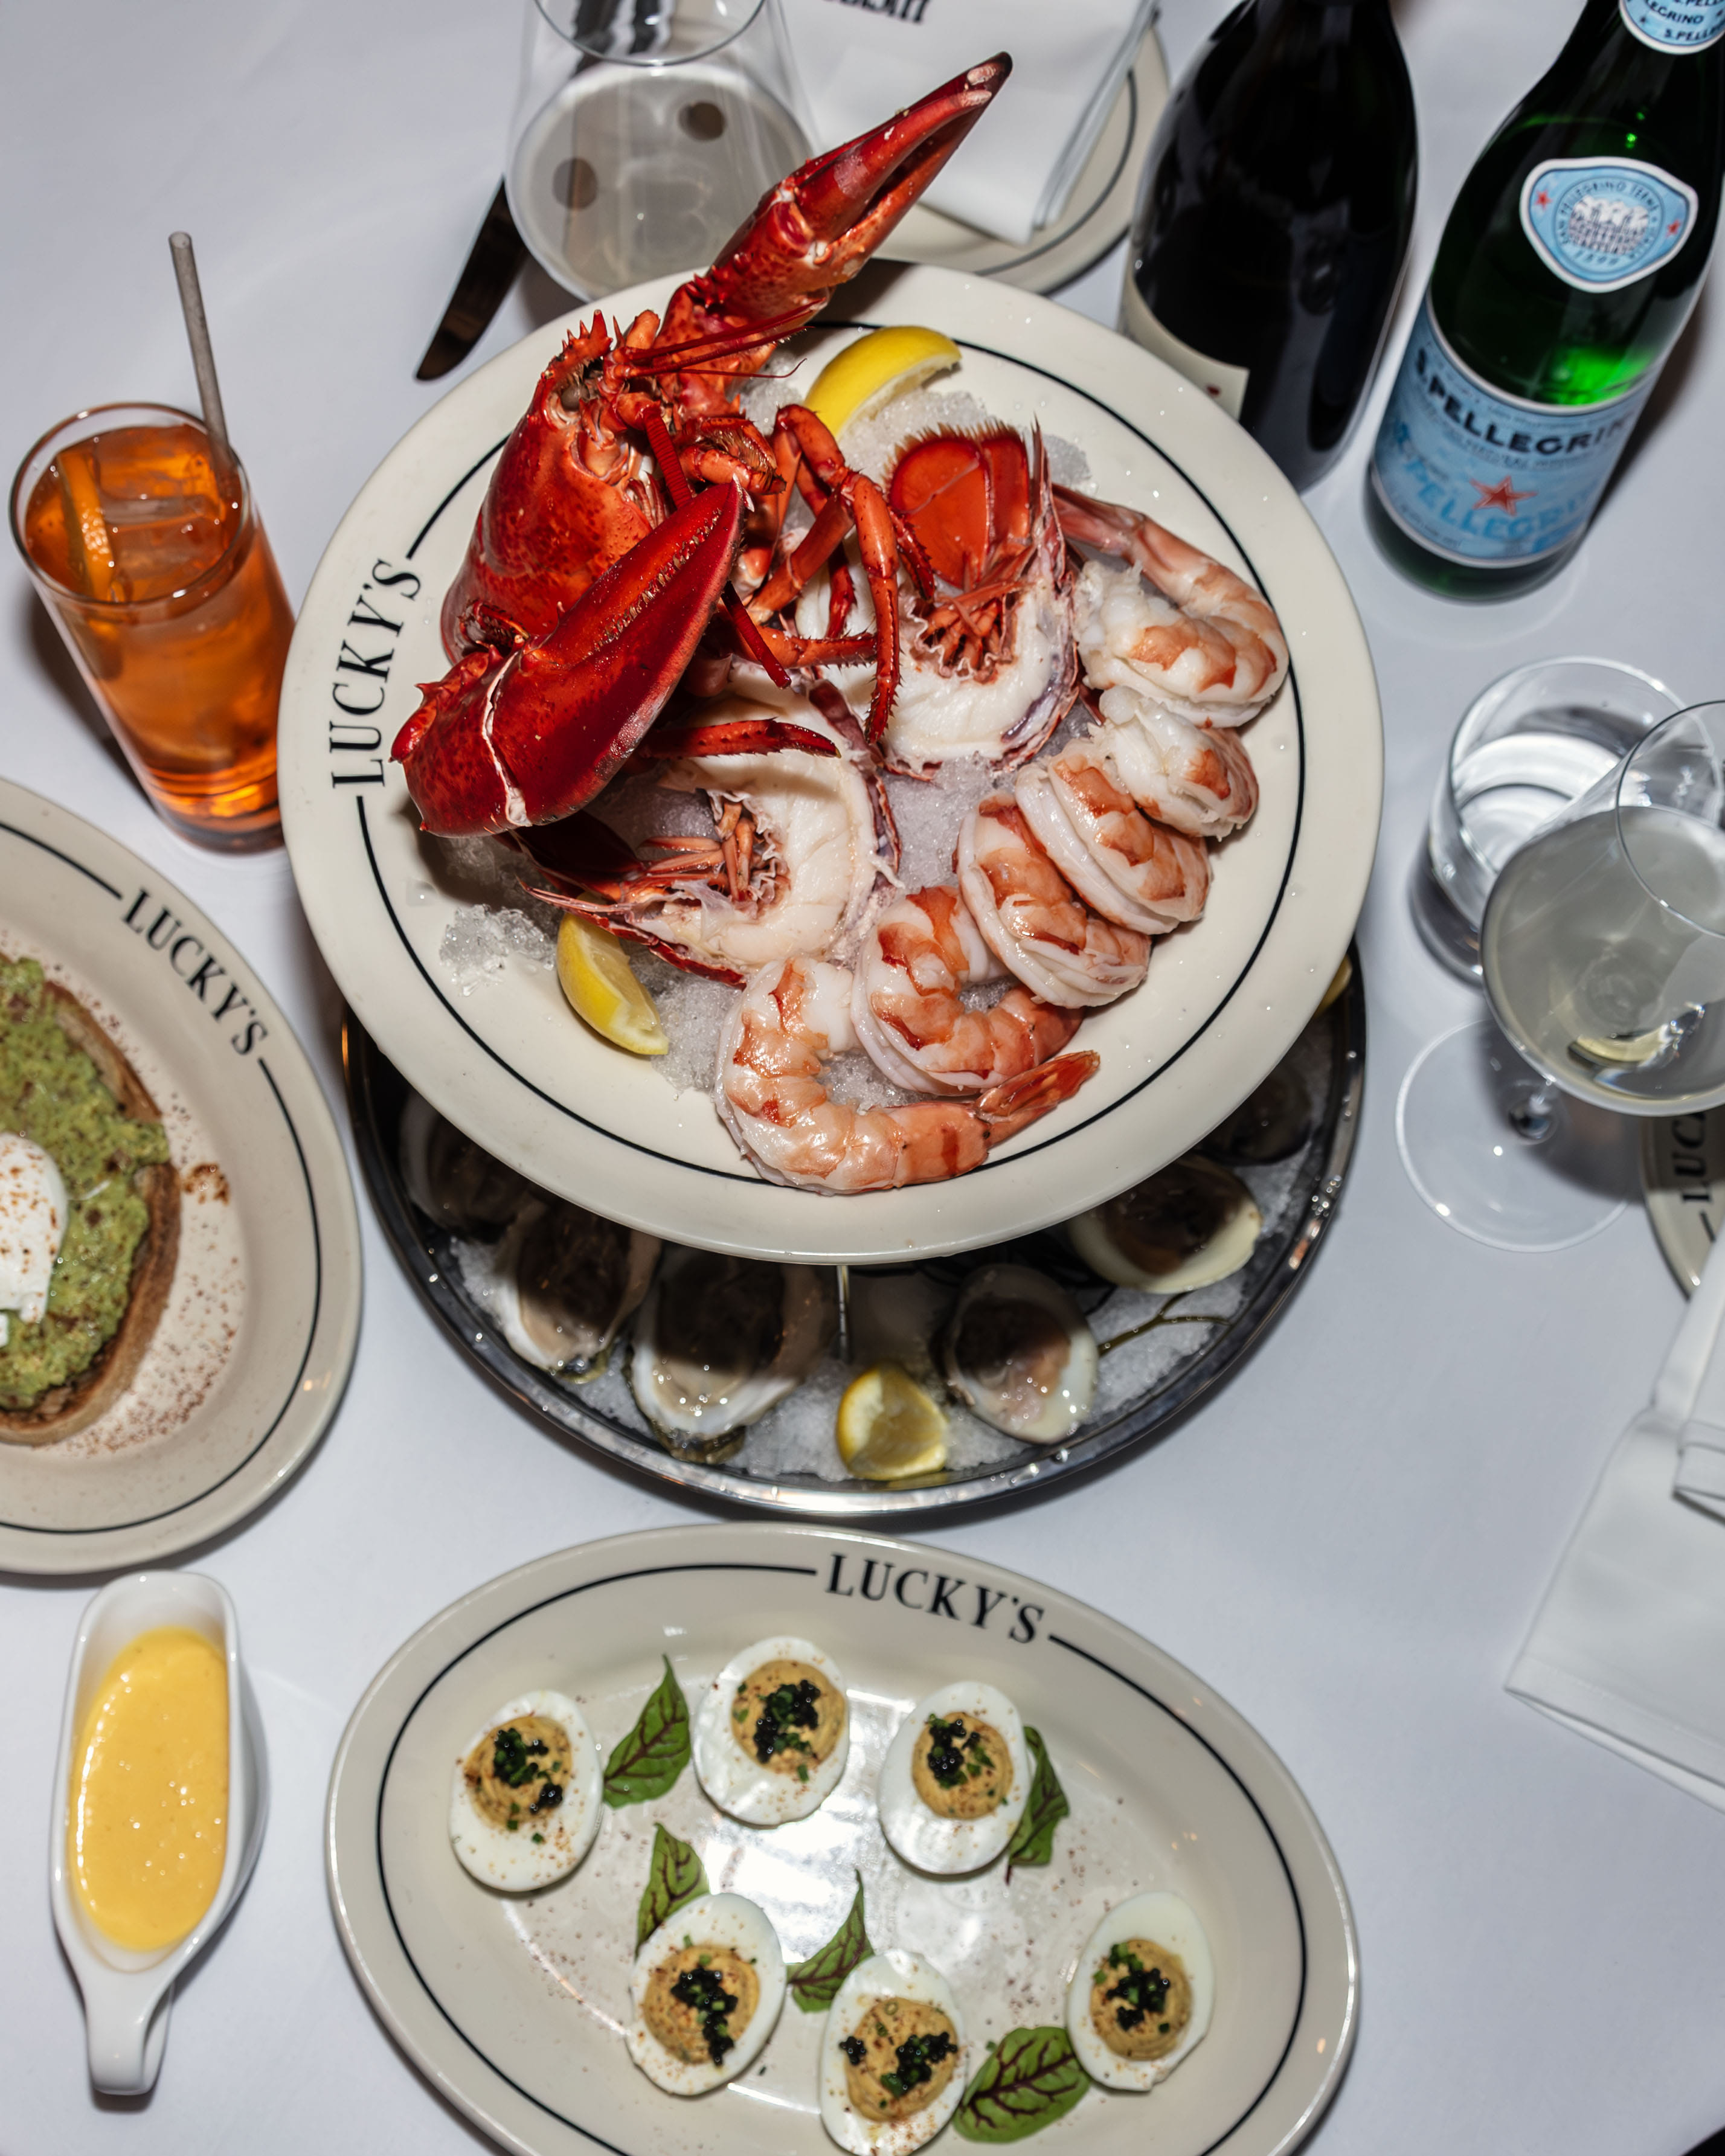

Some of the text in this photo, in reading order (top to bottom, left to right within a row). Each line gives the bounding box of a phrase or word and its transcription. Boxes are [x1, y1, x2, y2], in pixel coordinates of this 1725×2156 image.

[329, 558, 420, 788] LUCKY'S
[121, 887, 268, 1055] LUCKY'S
[1672, 1112, 1713, 1203] LUC
[825, 1553, 1044, 1643] LUCKY'S
